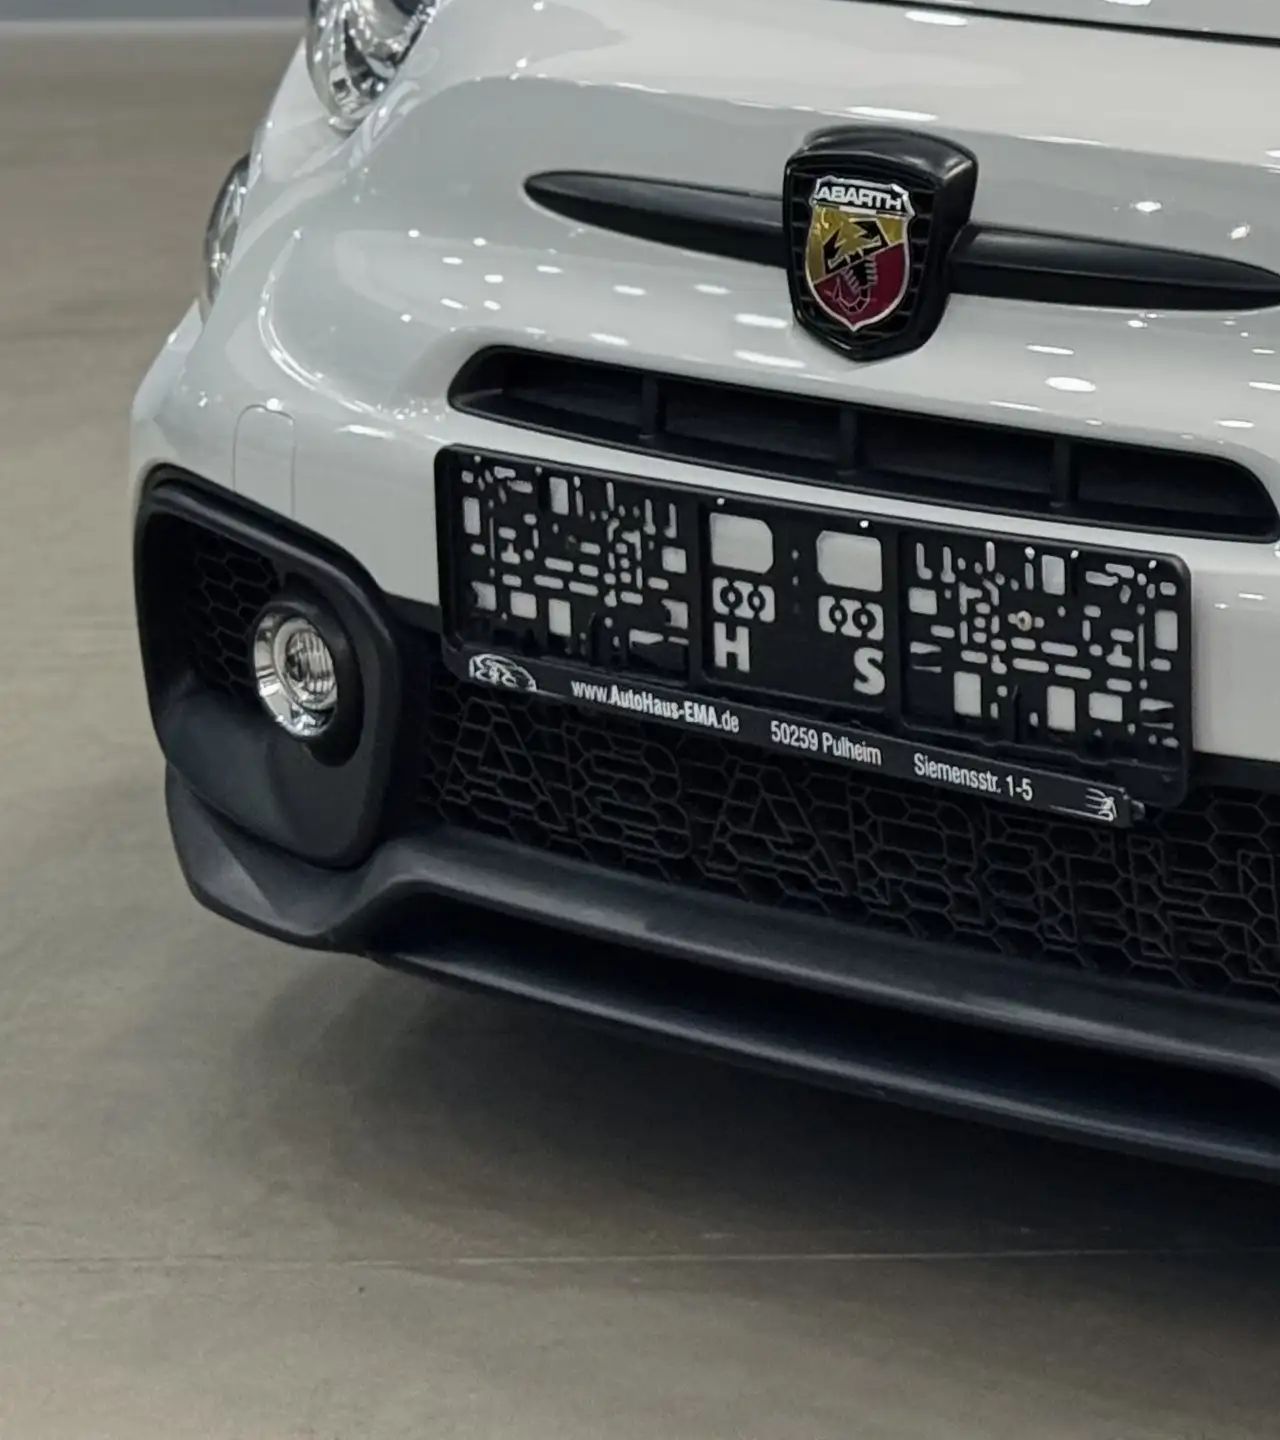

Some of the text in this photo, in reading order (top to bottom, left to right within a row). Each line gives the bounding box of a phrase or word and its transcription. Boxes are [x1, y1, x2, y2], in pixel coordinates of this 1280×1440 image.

[815, 186, 902, 210] ABARTH
[713, 621, 886, 696] H S
[571, 680, 1033, 801] www.AutoHaus-EMA.de 50259 Pulheim Siemensstr. 1-5
